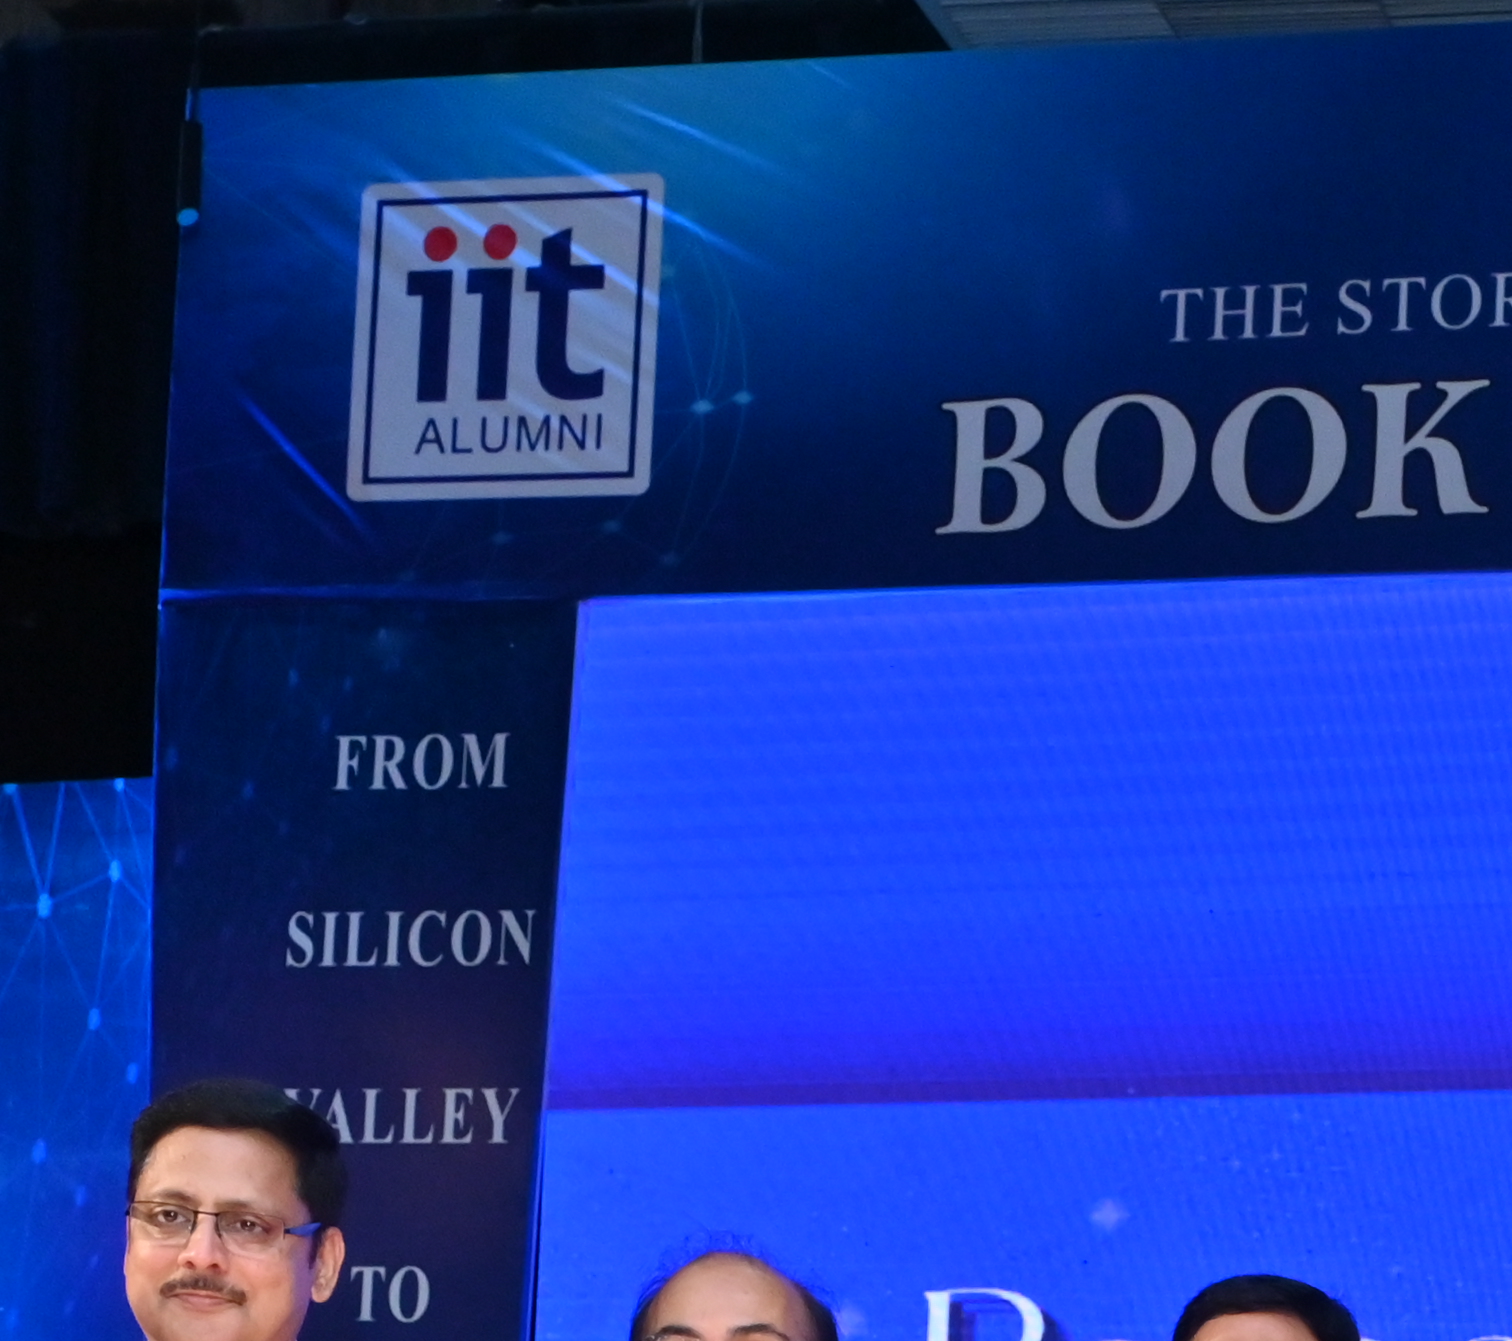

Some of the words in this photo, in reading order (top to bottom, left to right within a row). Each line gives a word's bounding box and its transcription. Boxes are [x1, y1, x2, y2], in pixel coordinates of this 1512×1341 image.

[406, 223, 605, 404] iit
[1161, 283, 1308, 341] THE
[414, 412, 604, 455] ALUMNI
[936, 380, 1490, 534] BOOK
[335, 733, 508, 790] FROM
[286, 910, 534, 967] SILICON
[351, 1266, 429, 1322] TO
